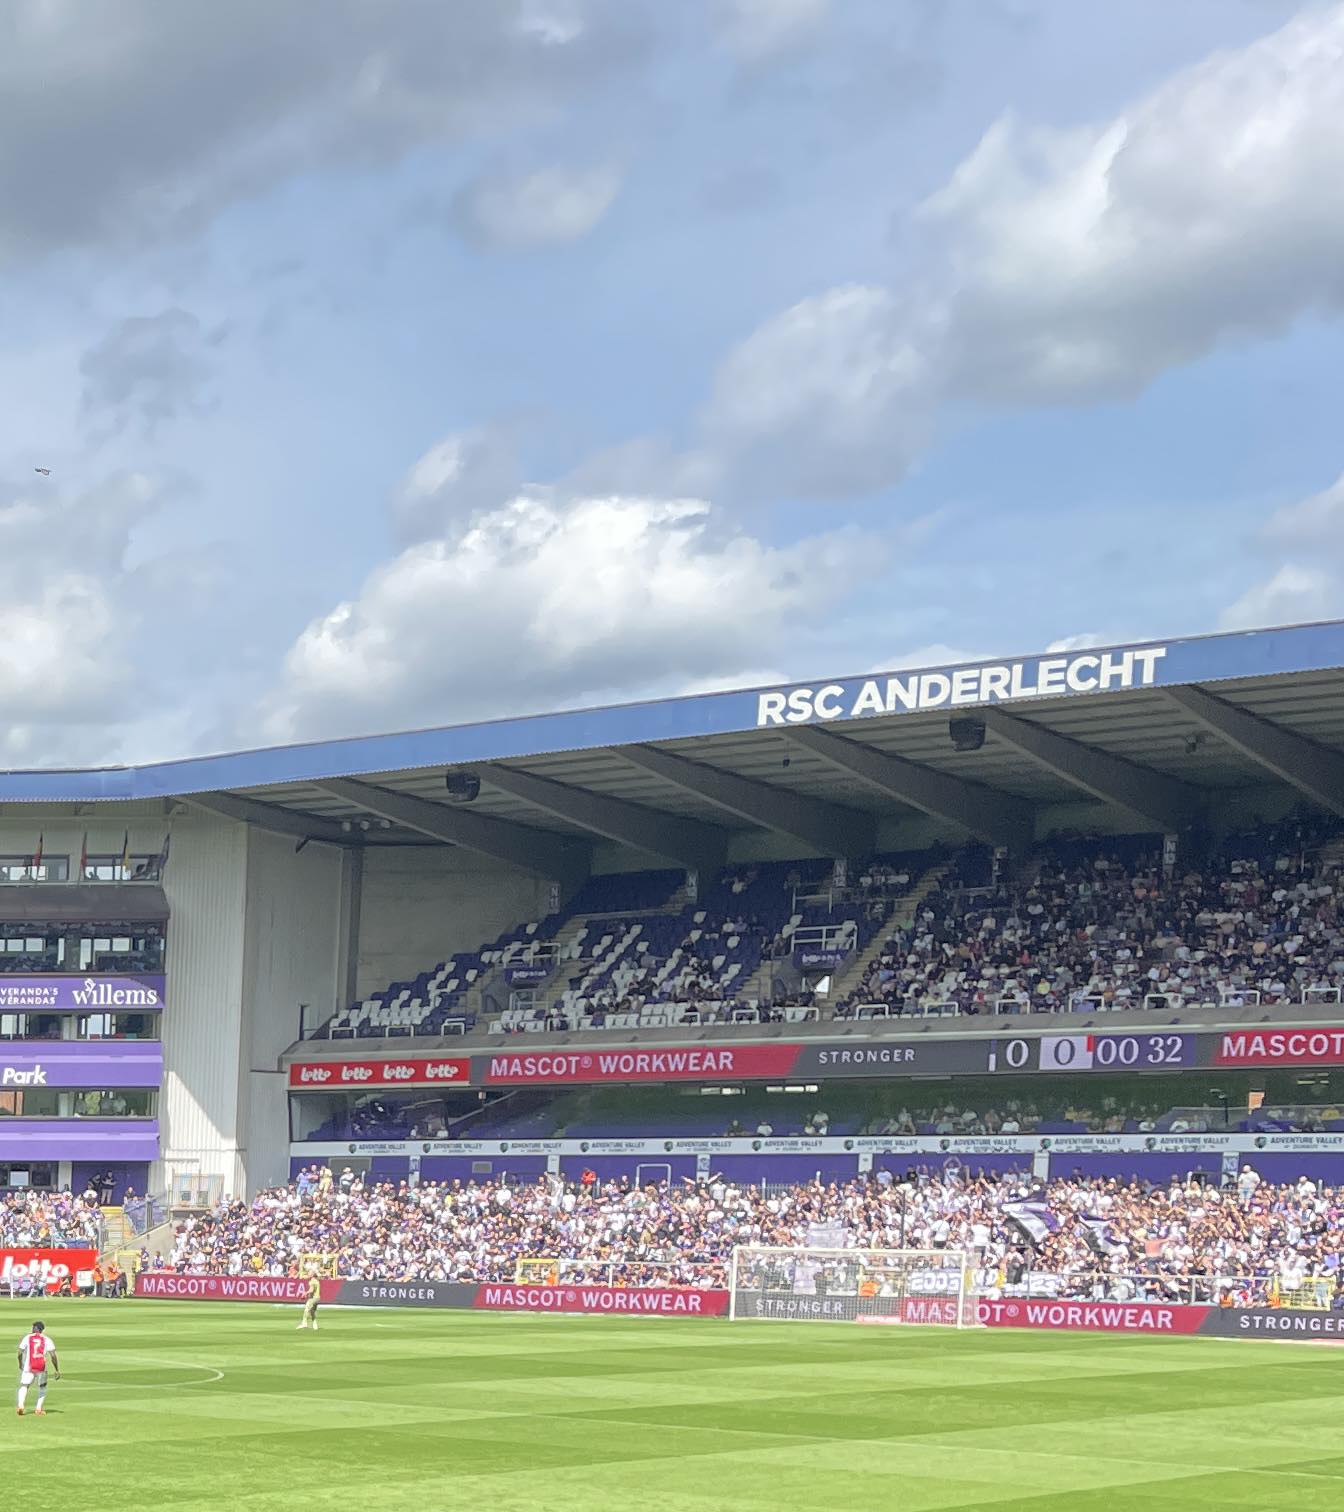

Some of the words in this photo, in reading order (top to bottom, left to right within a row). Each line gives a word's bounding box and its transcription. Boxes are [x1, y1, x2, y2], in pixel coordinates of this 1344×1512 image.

[757, 686, 843, 726] RSC
[850, 648, 1167, 717] ANDERLECHT
[72, 981, 158, 1006] willems
[818, 1048, 915, 1064] STRONGER
[1006, 1039, 1029, 1067] 0
[1054, 1038, 1076, 1065] 0
[1147, 1035, 1183, 1064] 32
[1222, 1033, 1344, 1057] MASCOT
[599, 1051, 734, 1073] WORKWEAR
[3, 1065, 47, 1085] Park
[221, 1280, 307, 1298] WORKWEA
[362, 1286, 435, 1300] STRONGER
[582, 1291, 701, 1311] WORKWEAR
[756, 1299, 844, 1315] STRONGER
[1026, 1304, 1173, 1329] WORKWEAR
[1240, 1315, 1344, 1332] STRONGER
